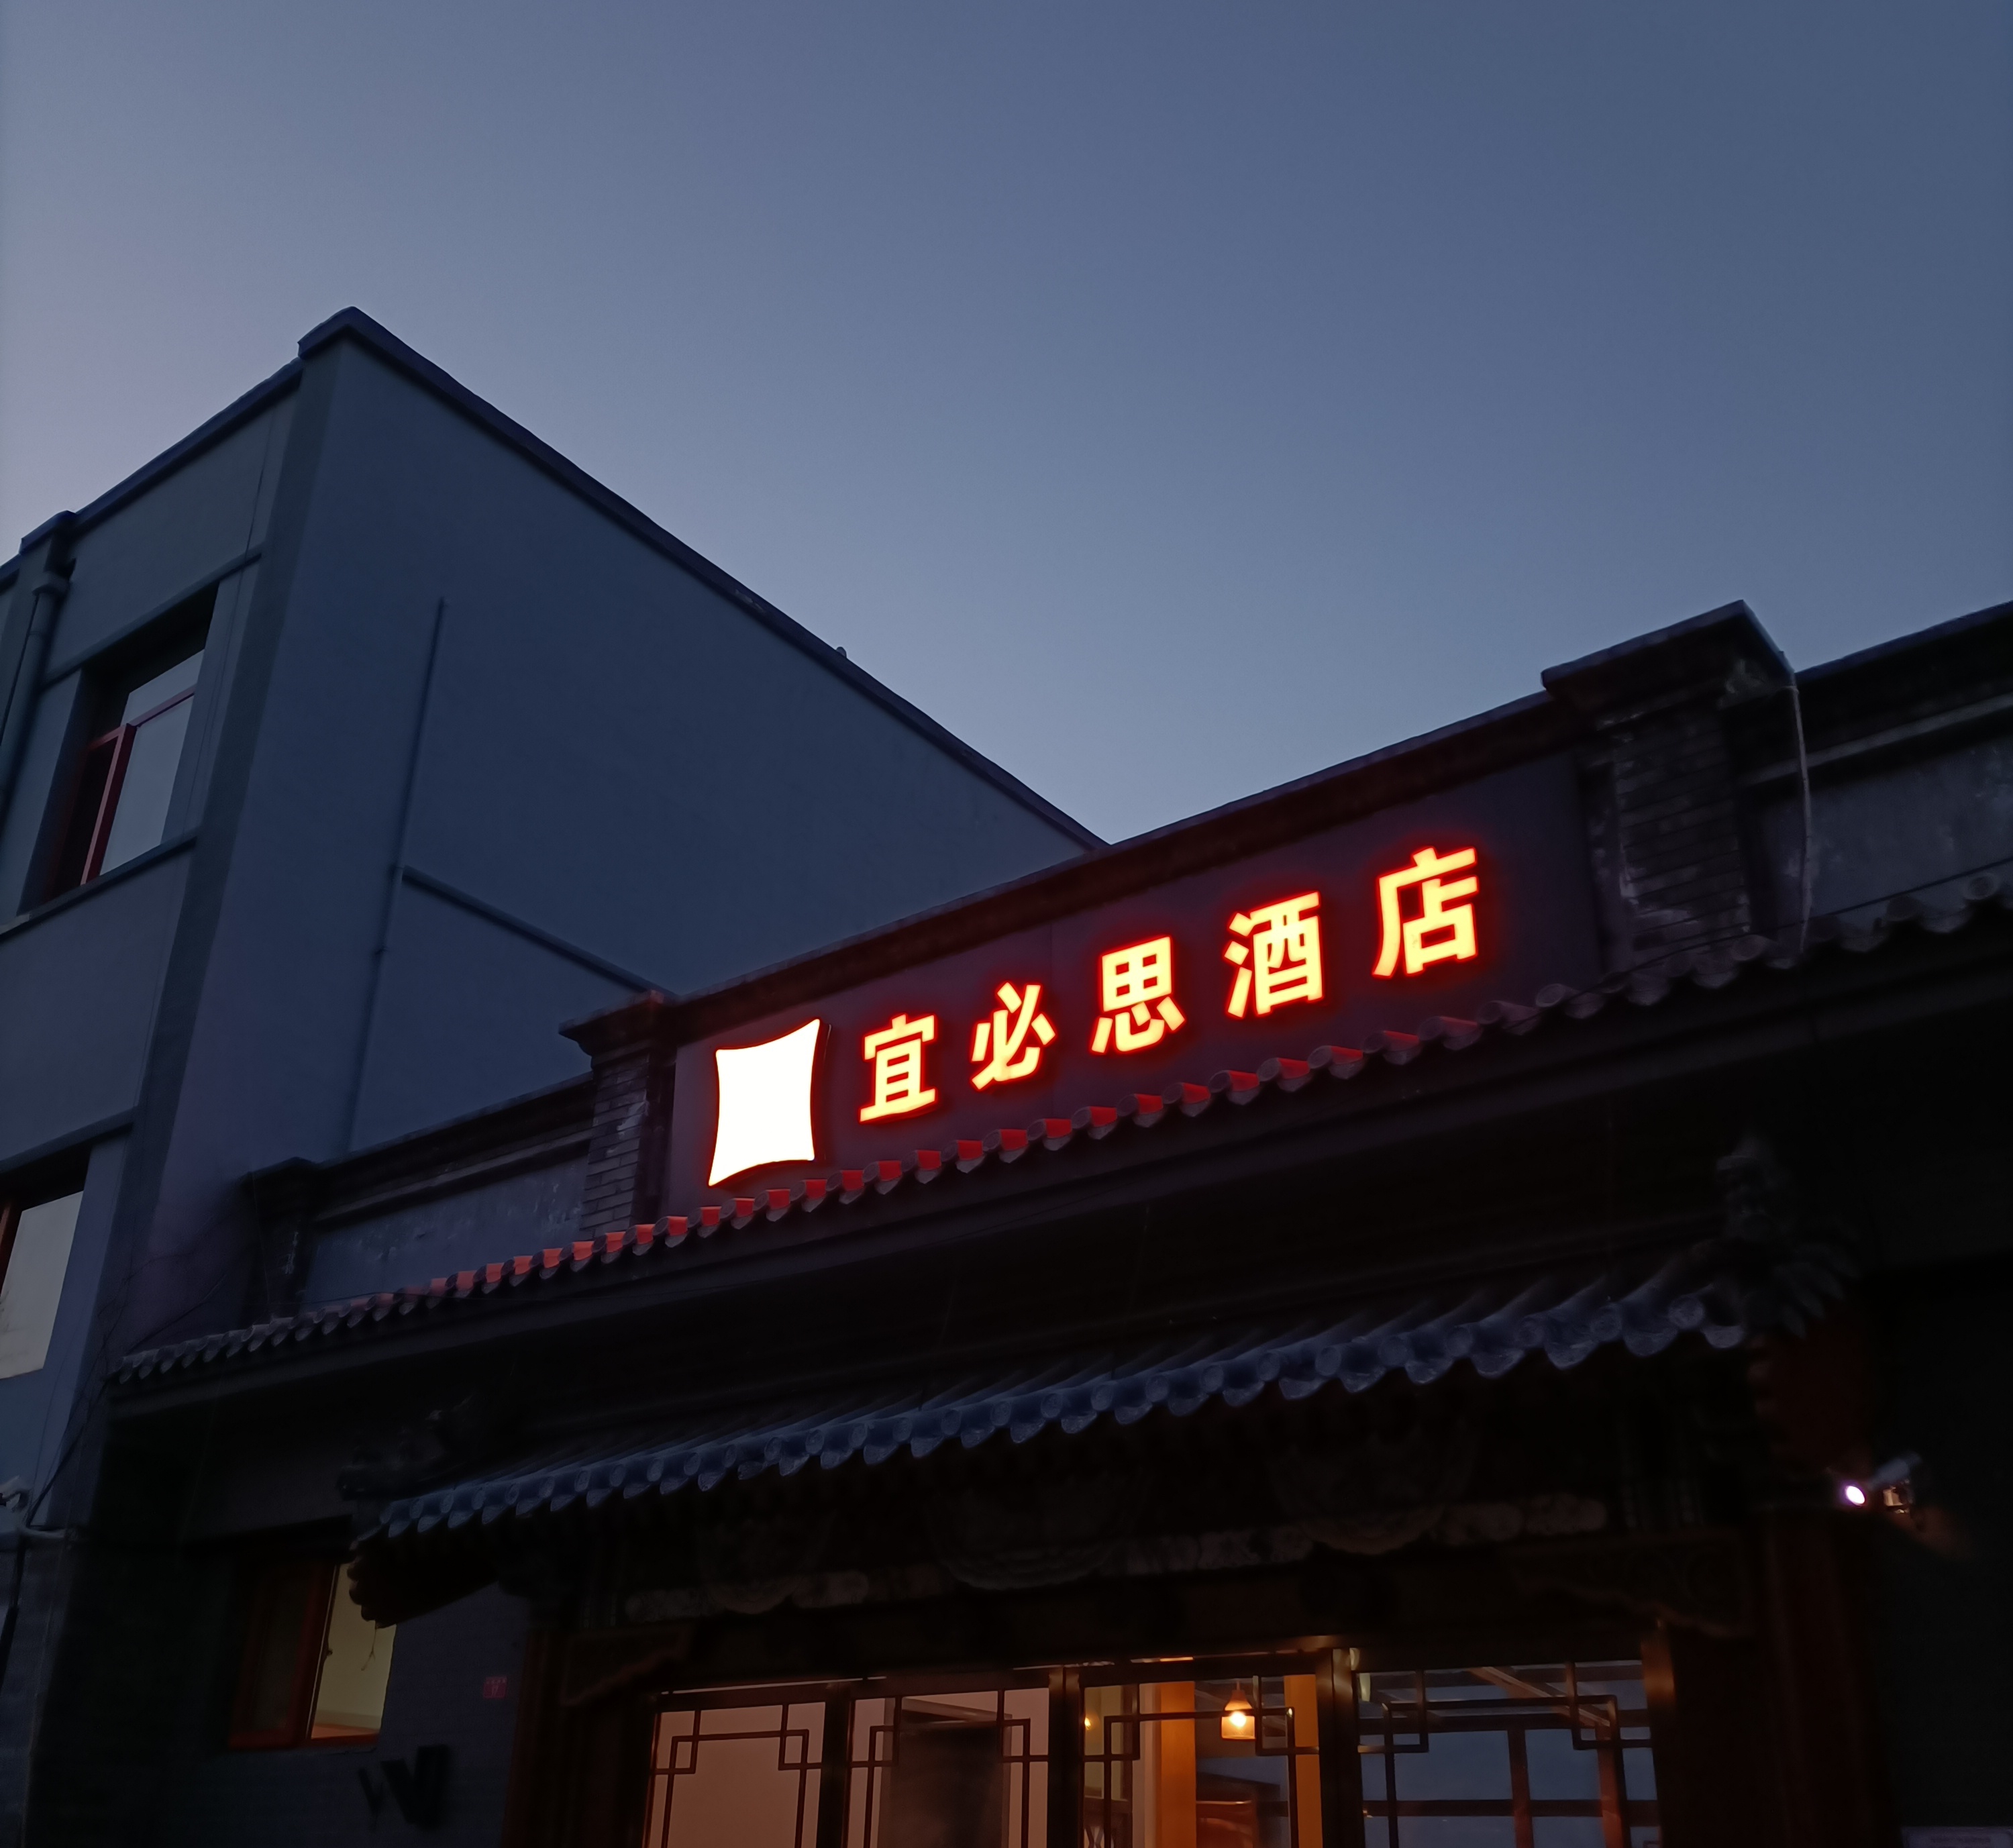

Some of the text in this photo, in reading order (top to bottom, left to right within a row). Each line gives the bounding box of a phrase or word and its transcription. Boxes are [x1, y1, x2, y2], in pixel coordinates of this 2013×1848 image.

[859, 846, 1480, 1123] 宜必思酒店
